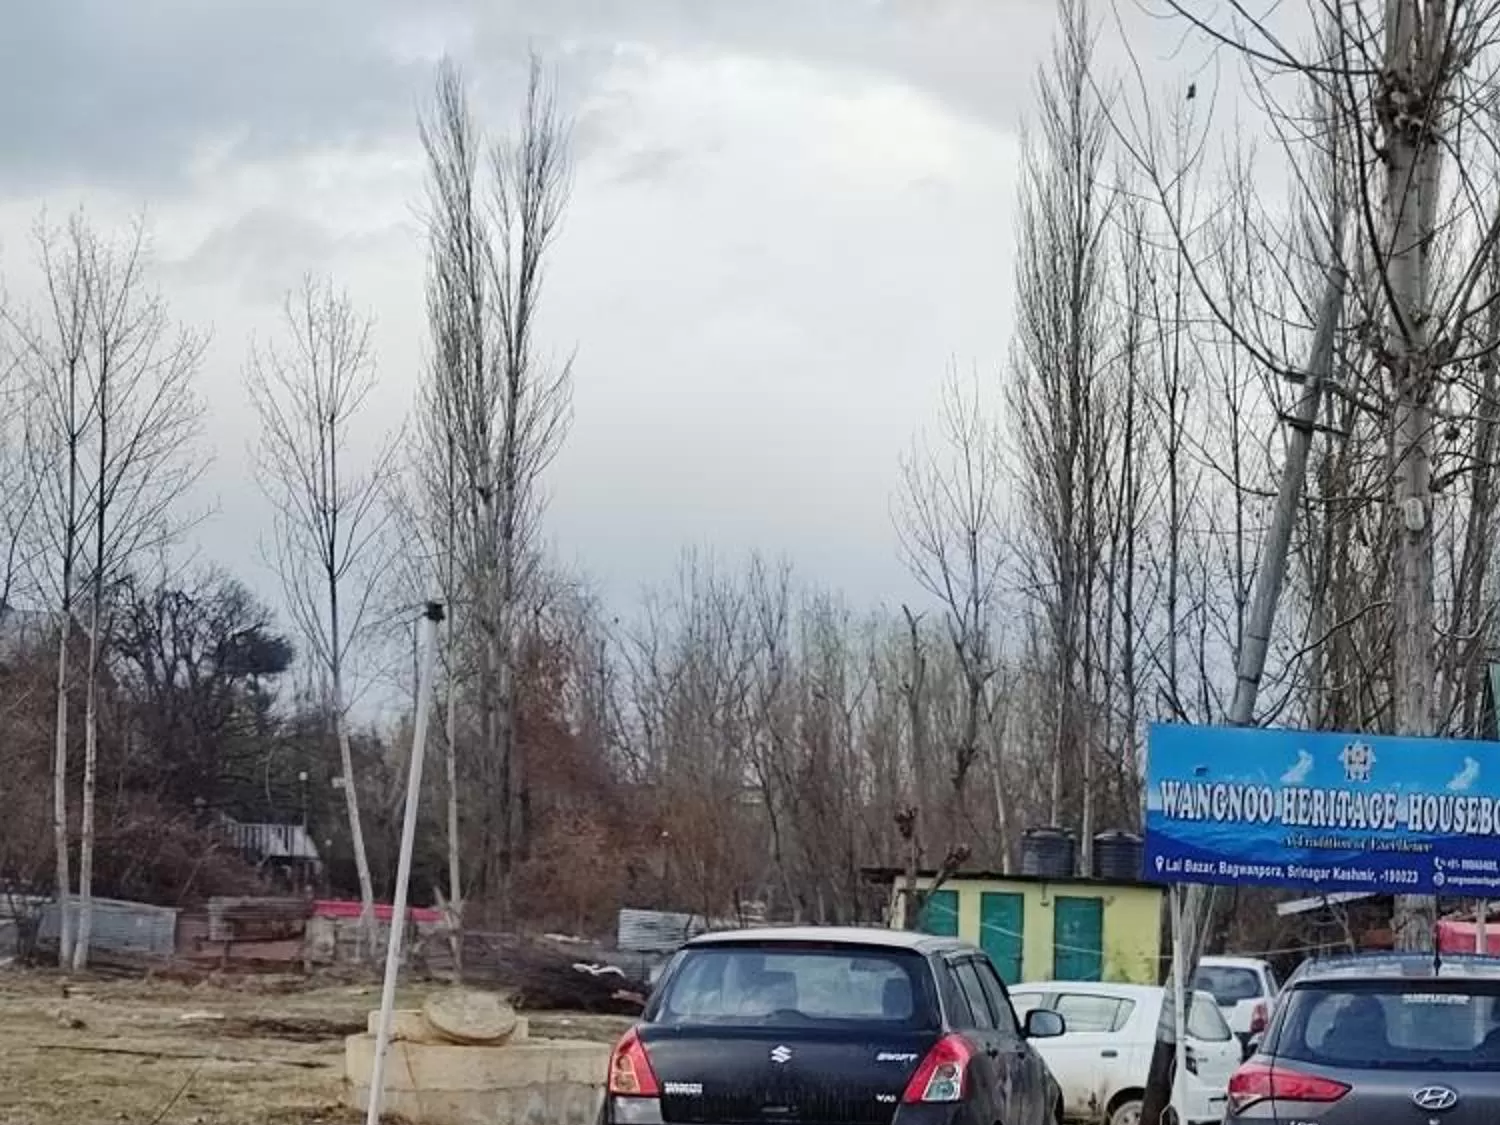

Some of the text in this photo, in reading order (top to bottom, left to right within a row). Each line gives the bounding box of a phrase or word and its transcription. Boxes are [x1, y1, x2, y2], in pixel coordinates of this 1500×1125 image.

[1160, 780, 1274, 824] WANGNOO
[1281, 787, 1398, 830] HERITAGE
[1165, 858, 1182, 872] Lal
[1184, 859, 1217, 875] Bazar,
[1287, 865, 1330, 882] Srinagar
[1333, 866, 1377, 884] Kashmir,
